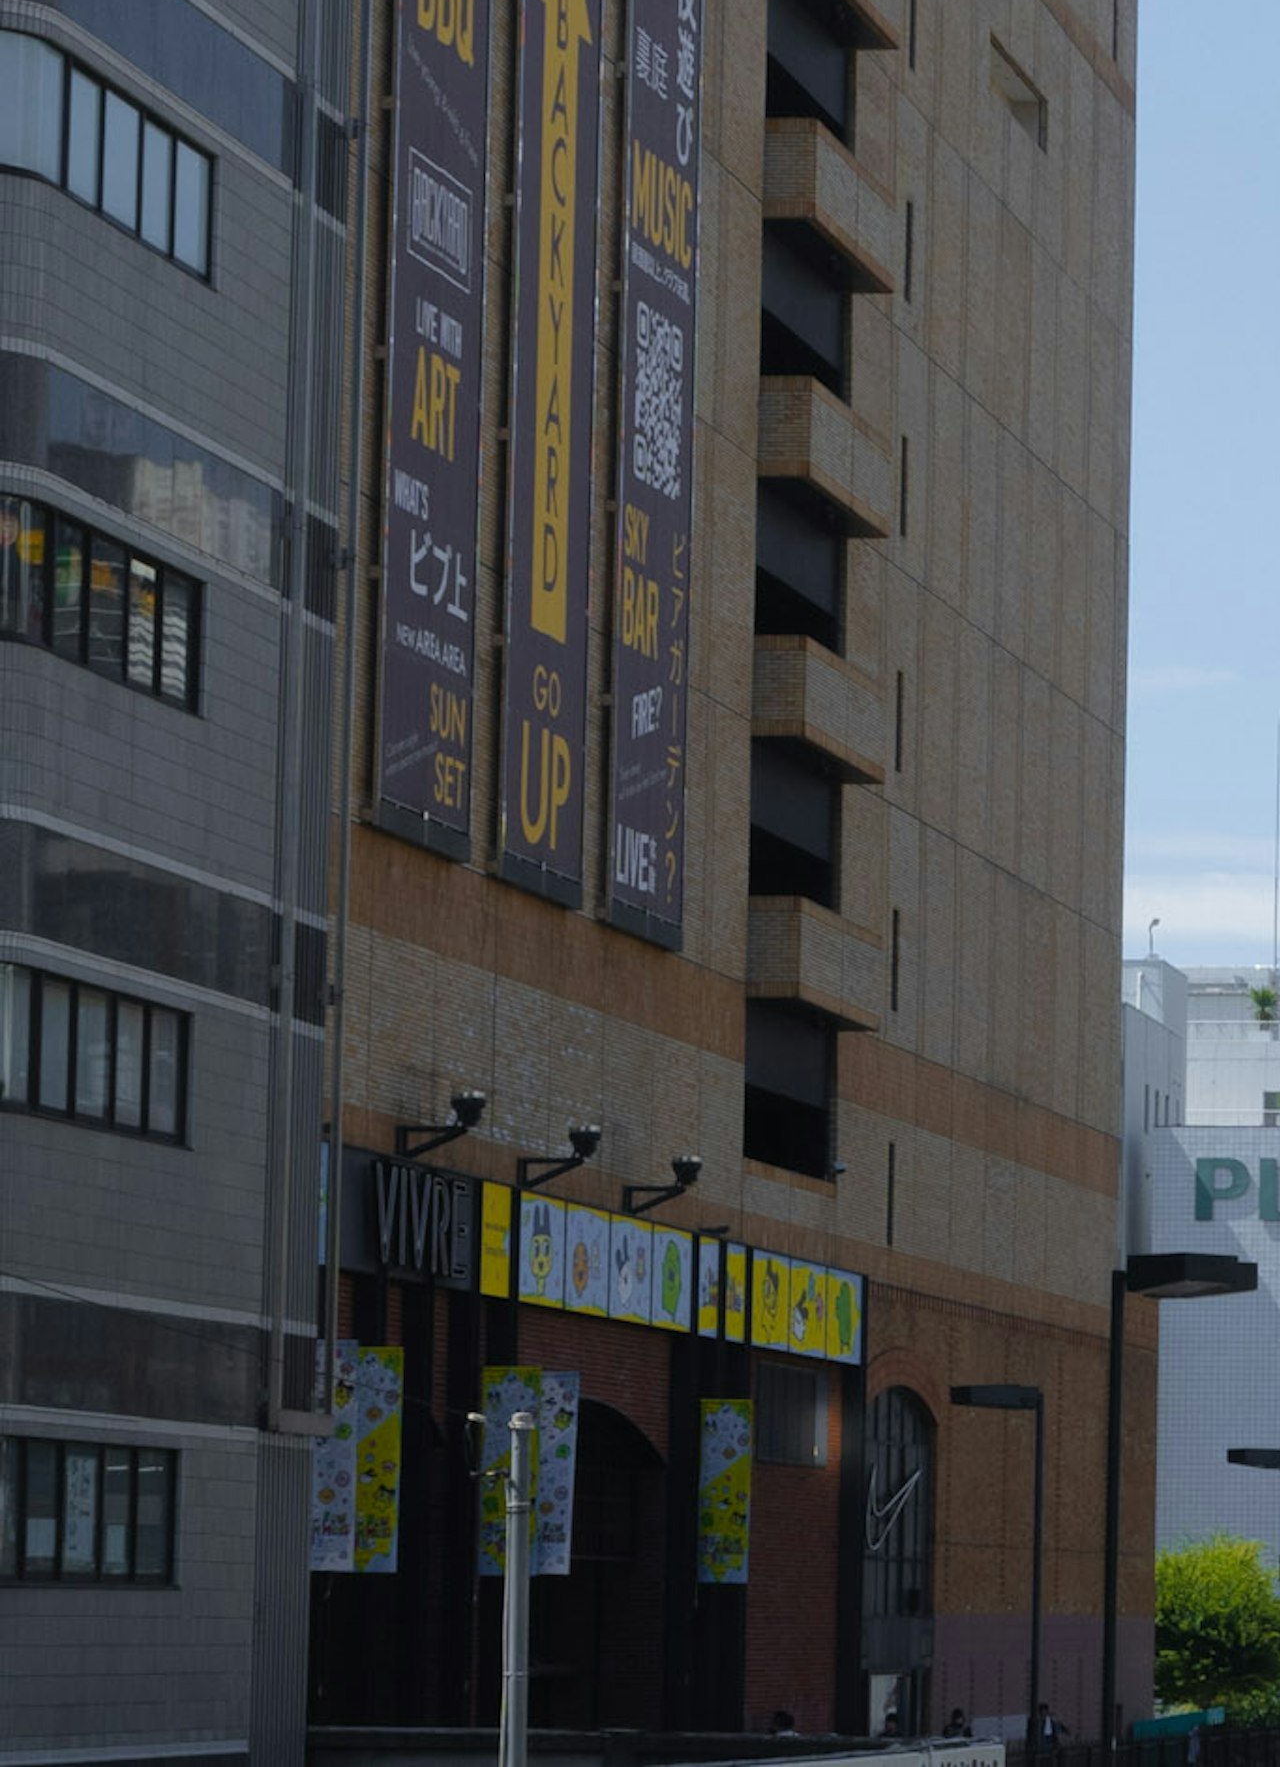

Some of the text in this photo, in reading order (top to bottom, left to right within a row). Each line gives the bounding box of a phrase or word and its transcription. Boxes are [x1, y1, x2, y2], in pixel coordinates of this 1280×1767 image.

[632, 139, 693, 269] MUSIC
[411, 345, 461, 463] ART
[624, 503, 650, 566] SKY
[622, 565, 659, 663] BAR
[430, 681, 466, 747] SUN
[532, 662, 561, 719] GO
[631, 684, 663, 740] FIRE?
[434, 751, 465, 810] SET
[519, 718, 571, 852] UP
[615, 823, 649, 893] LIVE
[373, 1158, 470, 1280] VIVRE
